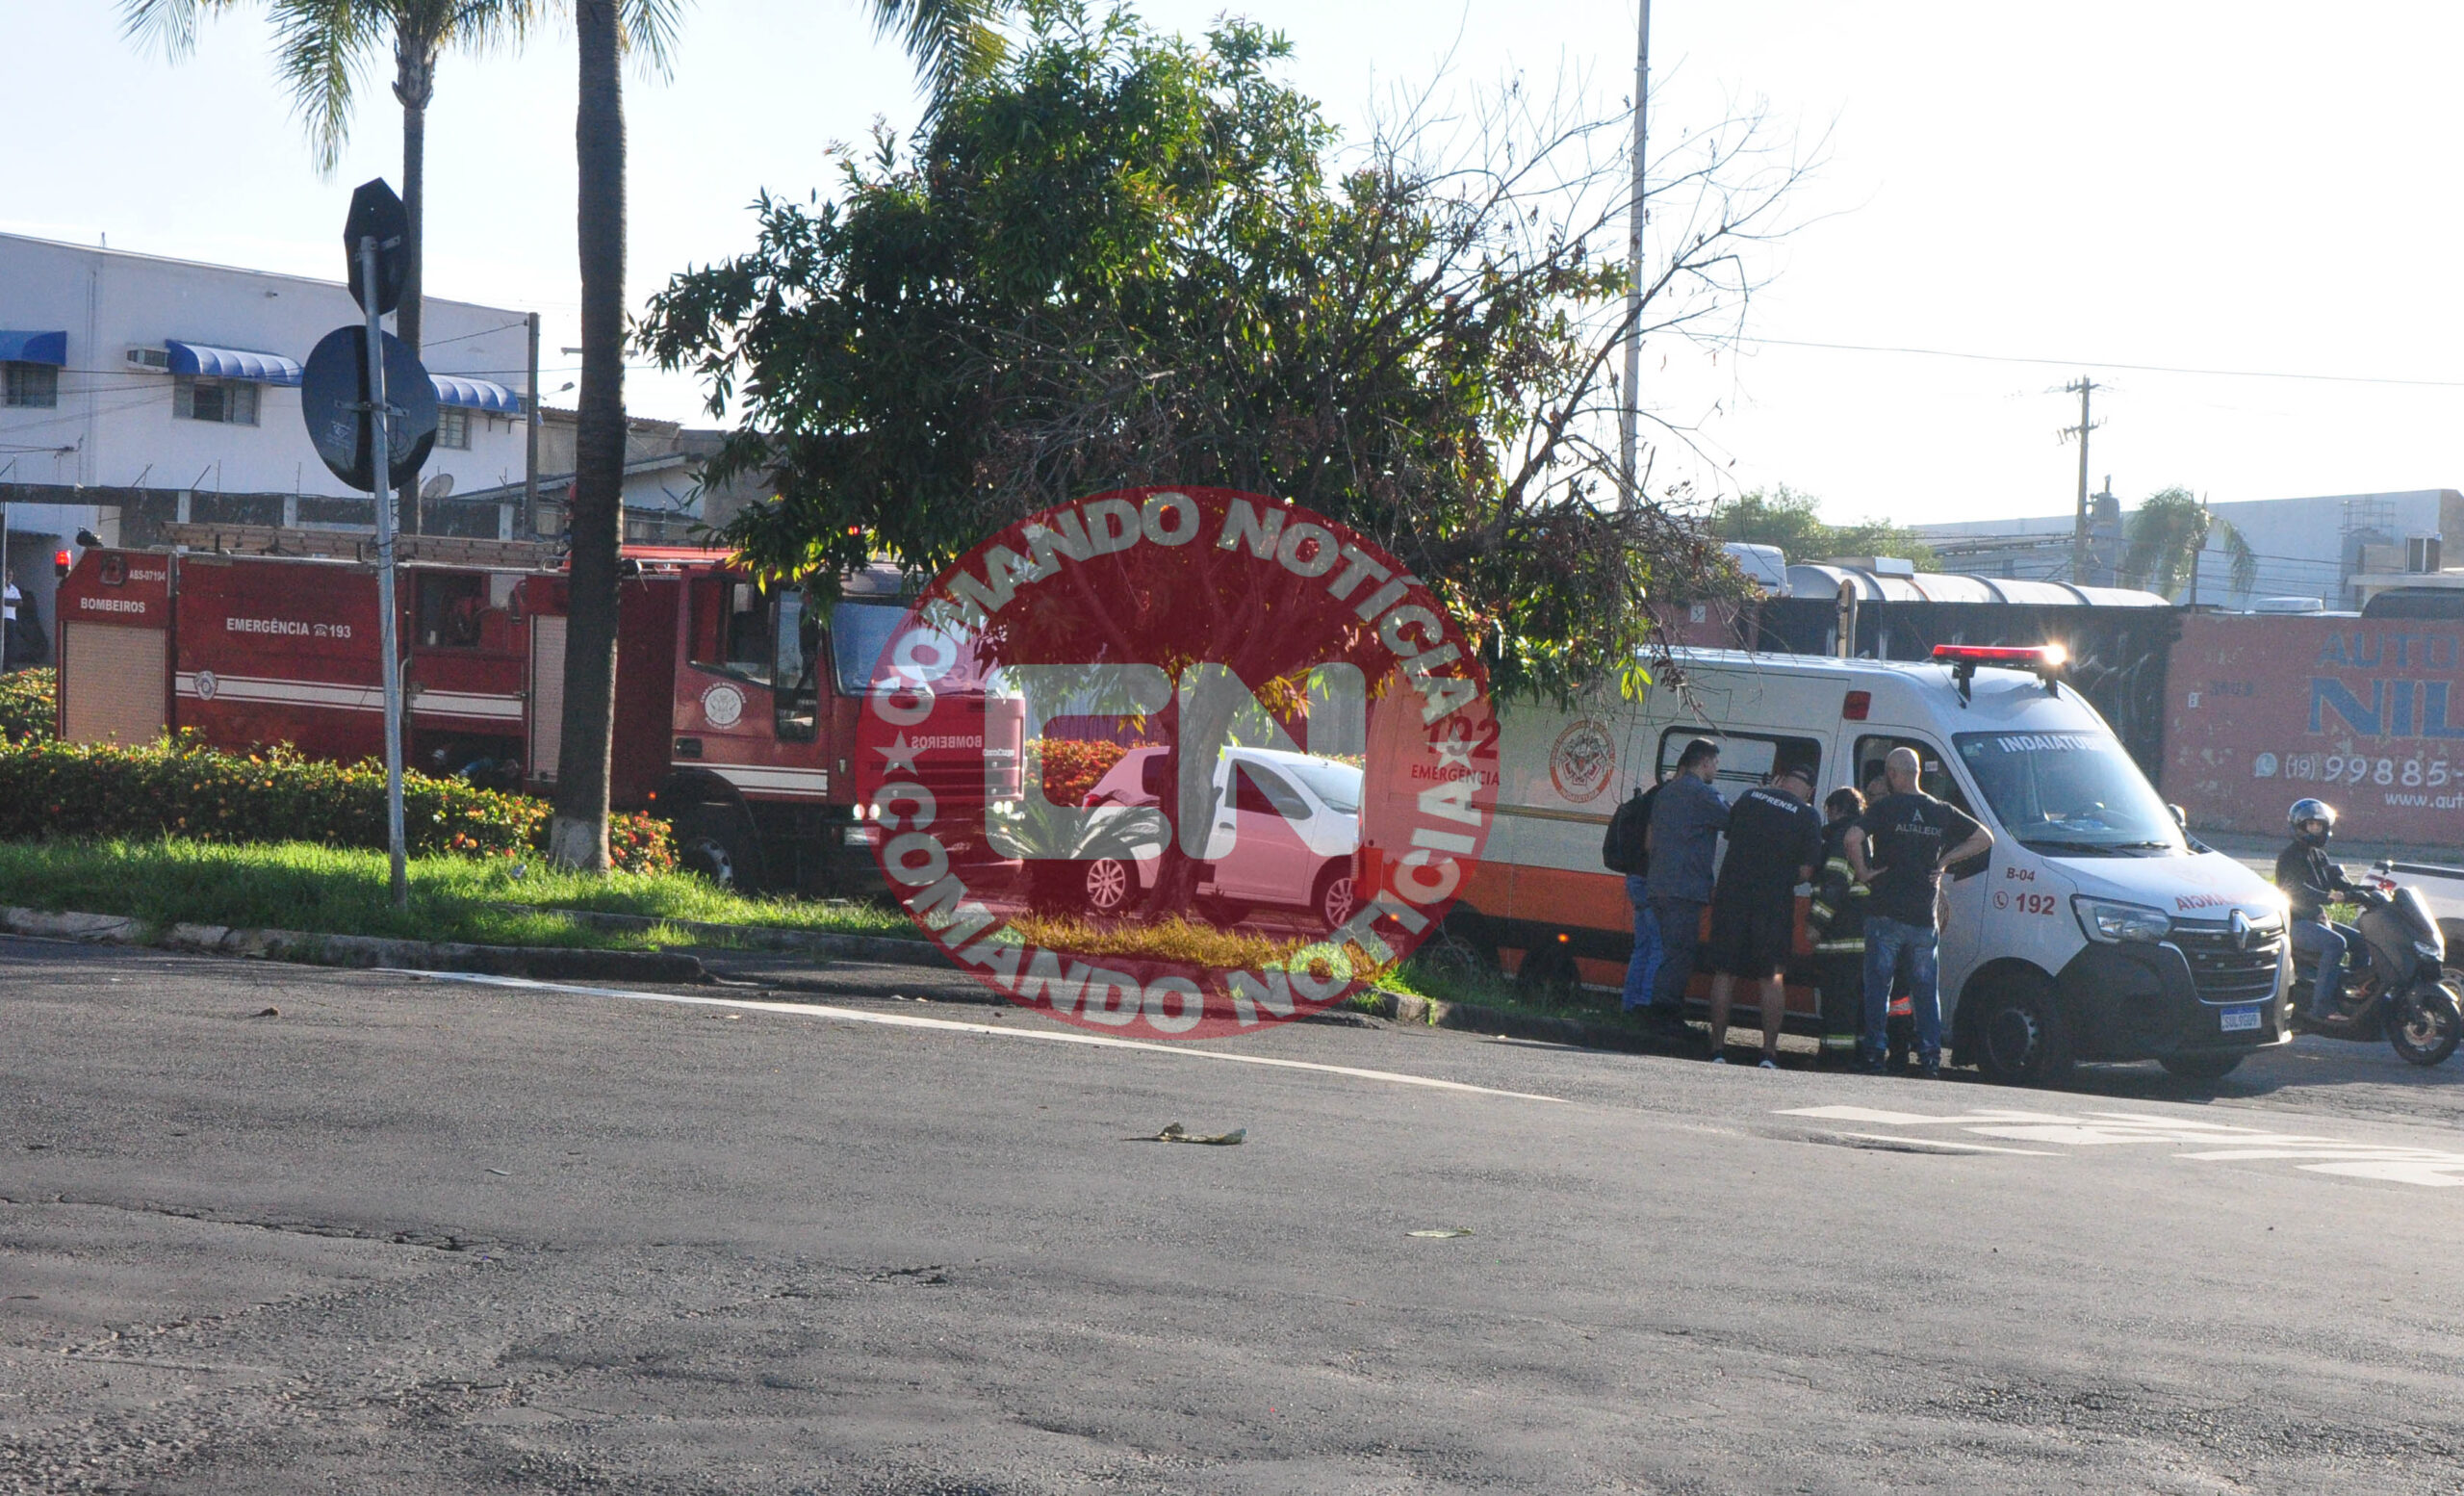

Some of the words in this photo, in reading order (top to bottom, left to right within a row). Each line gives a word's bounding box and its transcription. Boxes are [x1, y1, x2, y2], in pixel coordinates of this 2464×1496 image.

[80, 597, 145, 613] BOMBEIROS
[226, 617, 309, 635] EMERGÊNCIA
[329, 625, 351, 637] 193
[2314, 631, 2458, 669] AUTO
[1423, 715, 1501, 760] 192
[1997, 735, 2100, 752] INDAIATUB
[1411, 763, 1500, 787] EMERGÊNCIA
[2286, 754, 2316, 781] (19)
[1751, 790, 1798, 813] IMPRENSA
[2007, 867, 2035, 881] B-04
[2016, 893, 2055, 916] 192
